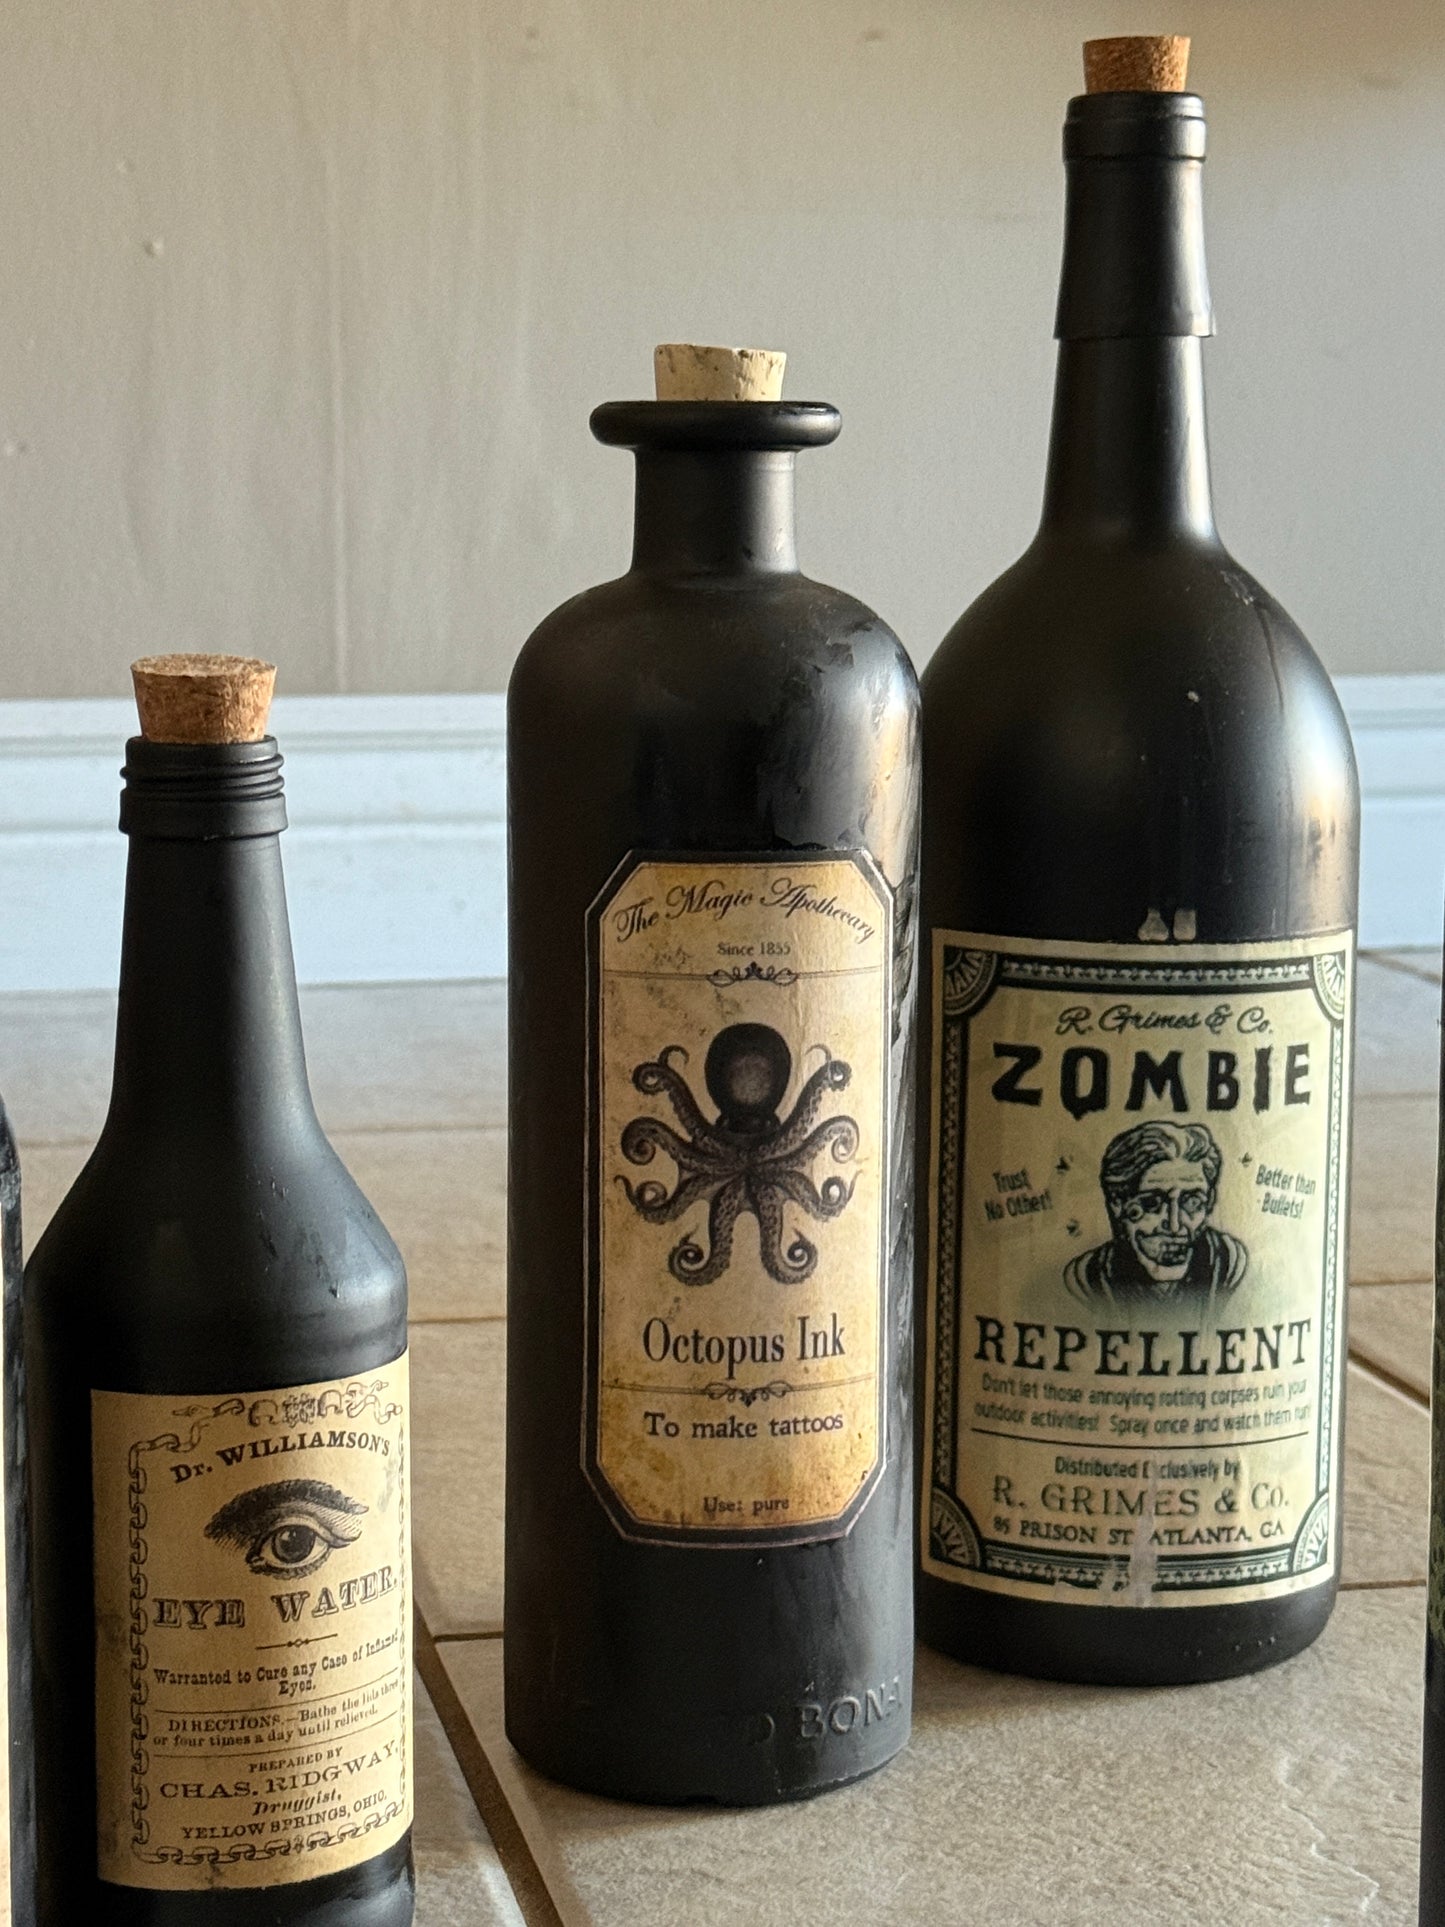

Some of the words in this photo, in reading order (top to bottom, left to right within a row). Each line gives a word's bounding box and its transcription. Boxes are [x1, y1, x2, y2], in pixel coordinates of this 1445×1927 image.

[614, 897, 659, 942] The
[665, 880, 754, 921] Magic
[759, 877, 876, 944] Apothecary
[717, 942, 755, 956] Since
[759, 941, 792, 956] 1855
[1055, 1006, 1094, 1036] R.
[1098, 1004, 1201, 1035] Grimes
[1204, 1003, 1234, 1036] &
[1236, 1005, 1274, 1035] Co.
[991, 1041, 1313, 1122] ZOMBIE
[992, 1168, 1033, 1193] Trust
[1255, 1164, 1294, 1191] Better
[1295, 1172, 1317, 1195] than
[984, 1199, 1005, 1221] No
[642, 1316, 786, 1381] Octopus
[796, 1312, 847, 1362] Ink
[973, 1315, 1312, 1377] REPELLENT
[981, 1371, 1016, 1397] Don't
[1019, 1379, 1039, 1400] let
[1042, 1381, 1084, 1404] those
[1088, 1387, 1156, 1413] annoying
[1158, 1387, 1207, 1411] rotting
[1210, 1385, 1261, 1409] corpses
[1262, 1379, 1286, 1401] ruin
[1287, 1378, 1308, 1402] your
[643, 1411, 680, 1438] To
[691, 1412, 758, 1439] make
[768, 1413, 844, 1436] tattoos
[974, 1401, 1026, 1424] outdoor
[1109, 1413, 1149, 1437] Spray
[1153, 1417, 1190, 1435] once
[1193, 1414, 1220, 1435] and
[1223, 1411, 1262, 1432] watch
[1263, 1407, 1292, 1428] them
[169, 1462, 213, 1484] Dr.
[215, 1430, 391, 1467] WILLIAMSON'S
[1054, 1455, 1138, 1479] Distributed
[1142, 1457, 1220, 1483] Eclusively
[1223, 1457, 1242, 1483] by
[752, 1498, 790, 1517] pure
[993, 1474, 1027, 1509] R.
[1040, 1482, 1201, 1517] GRIMES
[1213, 1486, 1241, 1514] &
[1250, 1481, 1290, 1510] Co.
[1018, 1519, 1099, 1544] PRISON
[152, 1597, 246, 1630] EYE
[153, 1668, 232, 1686] Warranted
[237, 1669, 252, 1684] to
[256, 1665, 288, 1682] Cure
[292, 1661, 317, 1678] any
[321, 1653, 348, 1671] Case
[352, 1644, 364, 1662] of
[341, 1697, 360, 1713] the
[153, 1735, 168, 1746] or
[173, 1734, 206, 1748] four
[209, 1734, 251, 1748] times
[255, 1734, 264, 1744] a
[267, 1729, 294, 1743] day
[297, 1718, 330, 1737] until
[248, 1752, 323, 1774] PREPARED
[326, 1745, 343, 1759] BY
[159, 1781, 259, 1800] CHAS.
[182, 1822, 265, 1840] YELLOW
[269, 1804, 352, 1834] SPRINGS,
